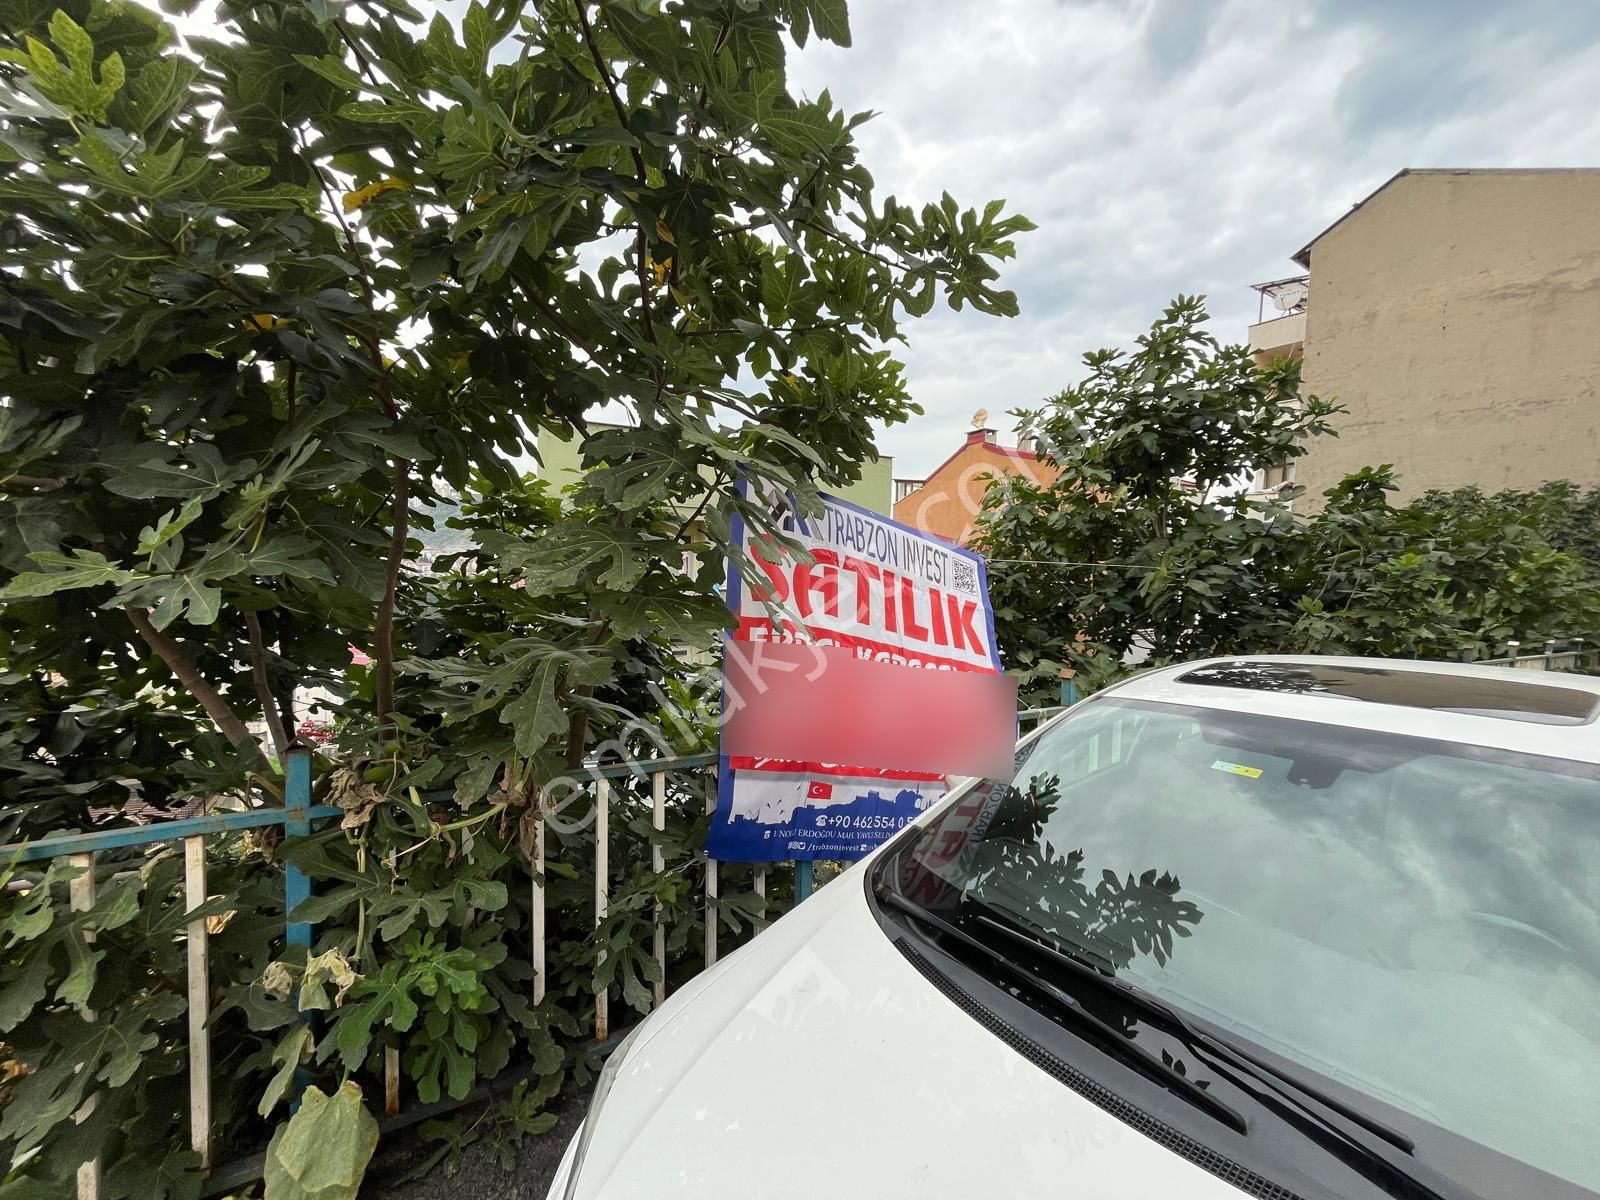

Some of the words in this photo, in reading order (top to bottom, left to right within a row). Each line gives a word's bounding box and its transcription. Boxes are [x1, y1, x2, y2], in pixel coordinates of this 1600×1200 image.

[824, 504, 898, 567] TRABZON
[902, 534, 950, 587] INVEST
[829, 814, 851, 828] +90
[798, 828, 836, 839] ERDOĞDU
